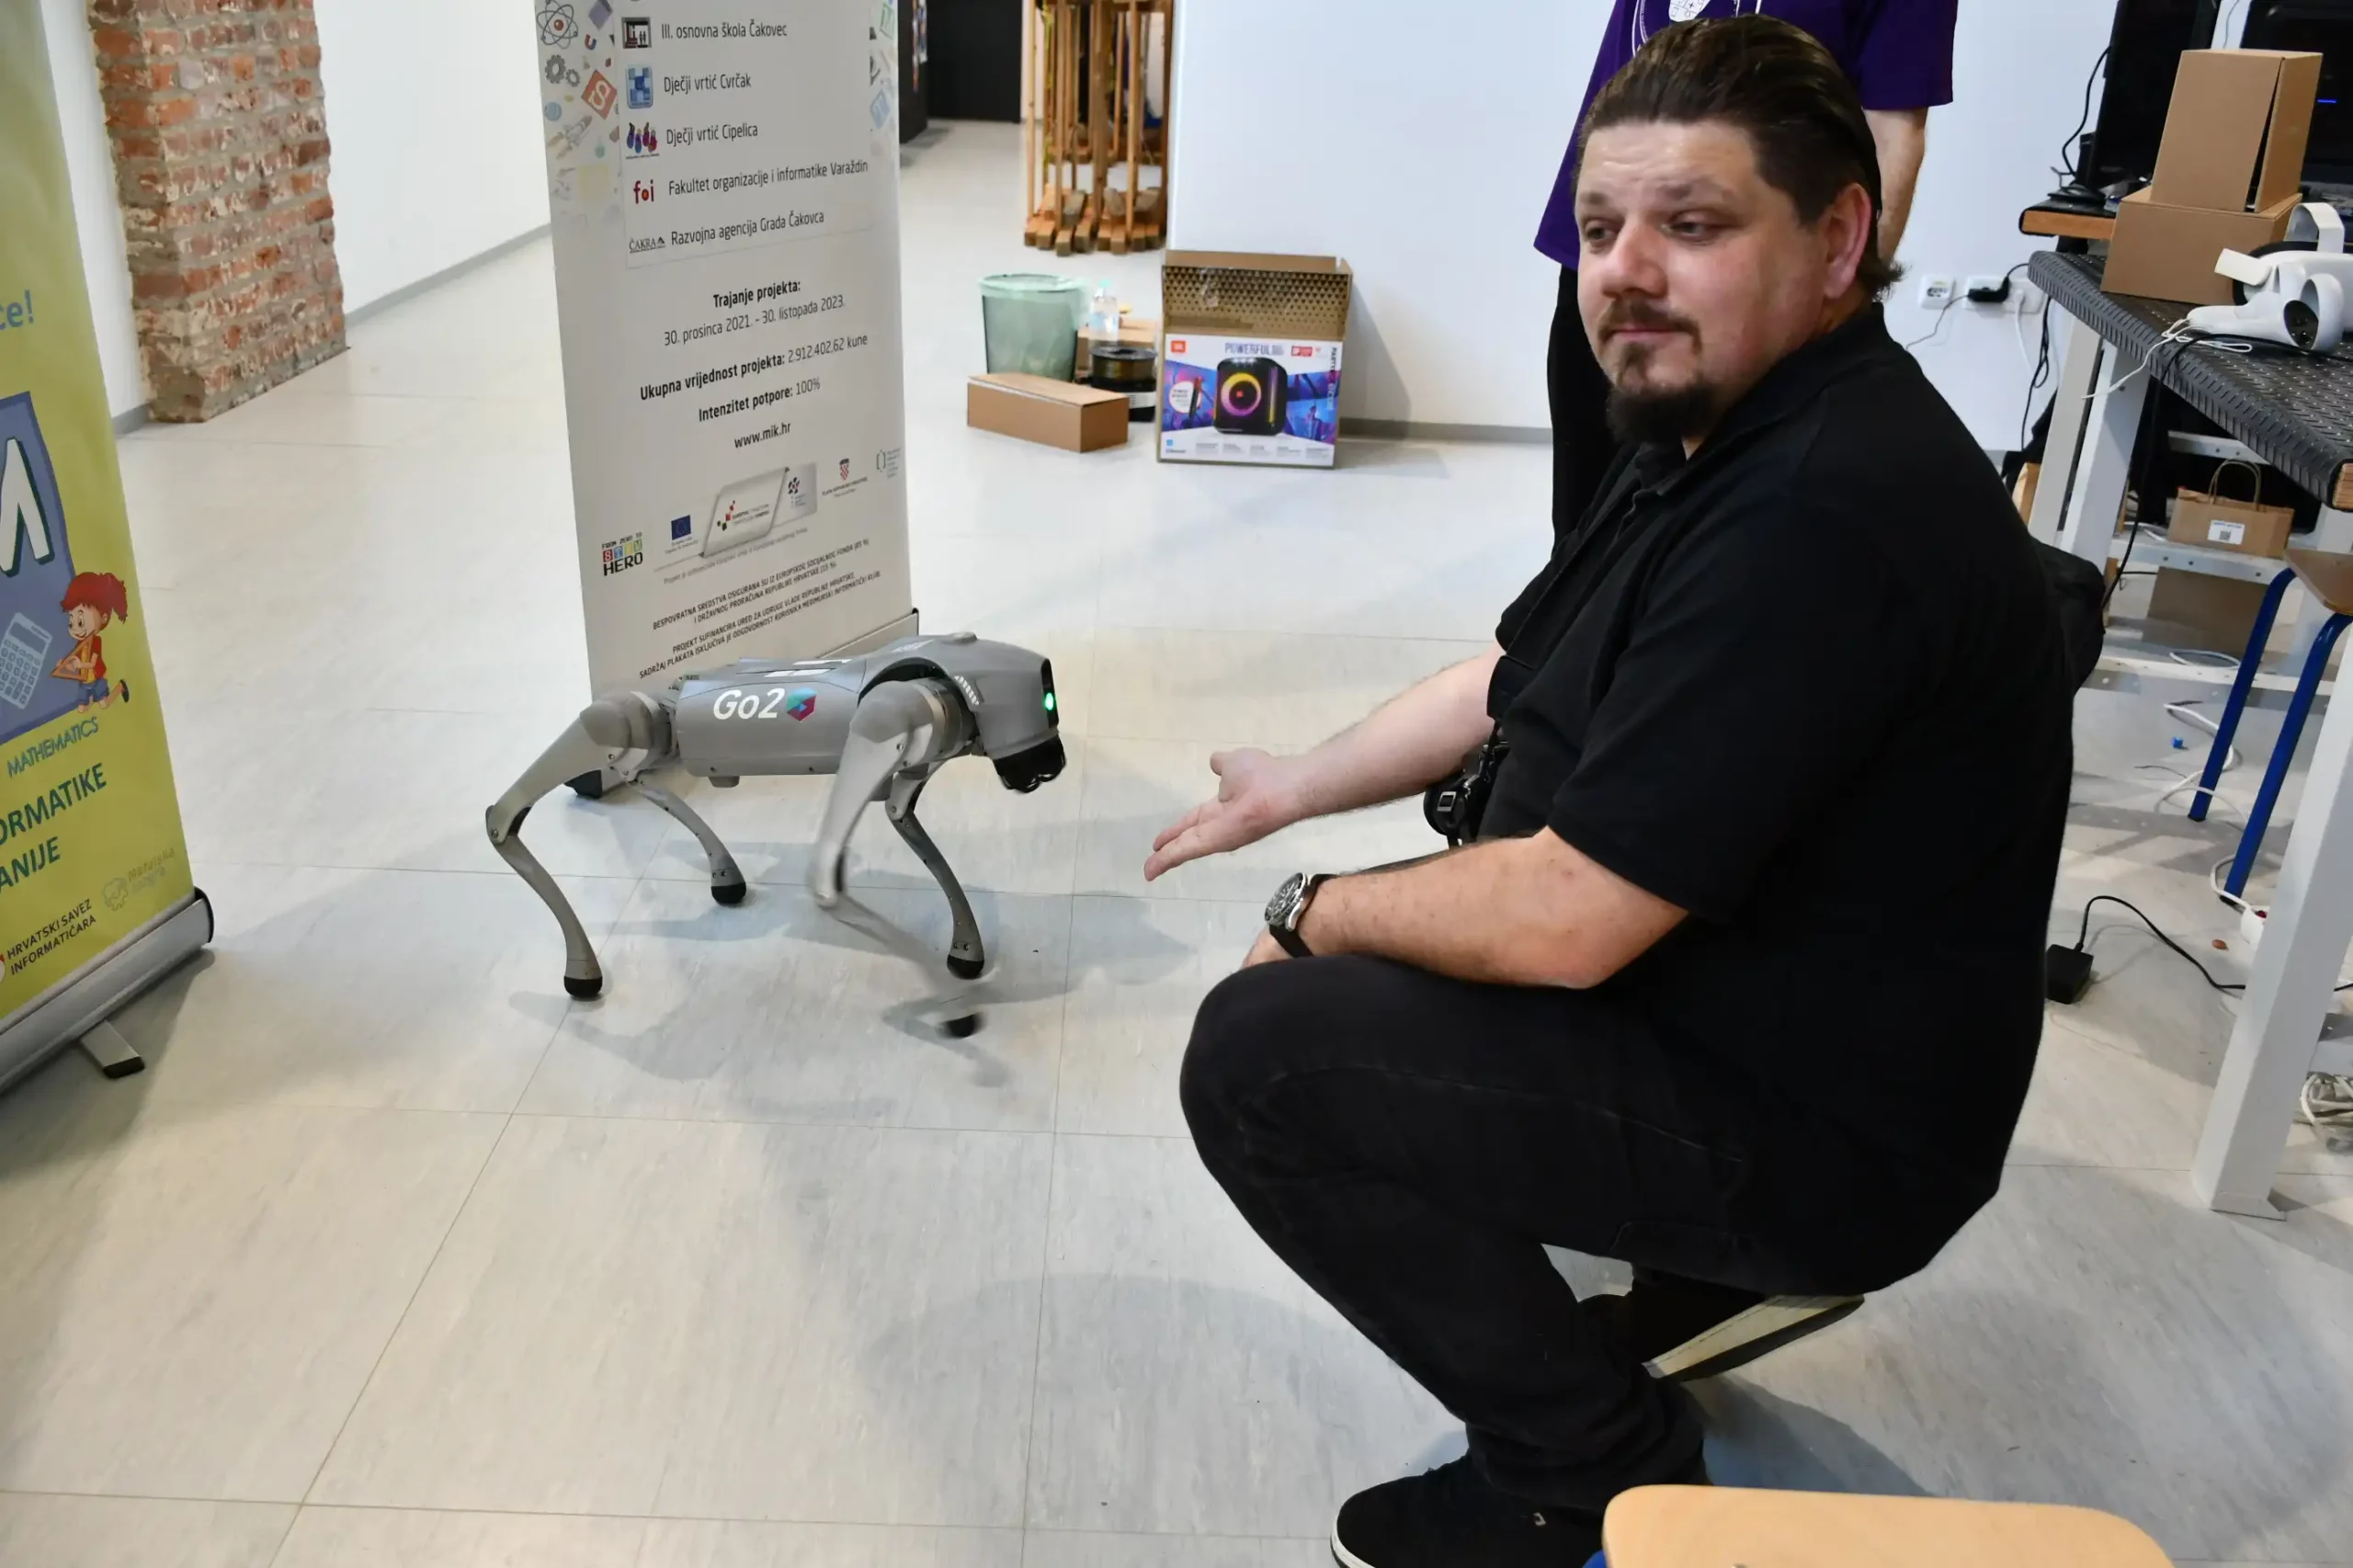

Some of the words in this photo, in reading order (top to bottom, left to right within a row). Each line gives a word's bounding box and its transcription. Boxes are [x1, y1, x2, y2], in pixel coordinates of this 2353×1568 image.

[662, 24, 675, 40] III.
[676, 25, 718, 39] osnovna
[722, 20, 746, 38] škola
[749, 18, 788, 37] Čakovec
[664, 74, 691, 94] Dječji
[695, 74, 717, 90] vrtić
[721, 73, 752, 90] Cvrčak
[666, 126, 694, 147] Dječji
[697, 124, 720, 142] vrtić
[722, 122, 758, 142] Cipelica
[633, 179, 654, 204] foi
[669, 176, 710, 197] Fakultet
[712, 171, 769, 195] organizacije
[771, 168, 775, 184] i
[777, 162, 827, 184] informatike
[830, 159, 869, 176] Varaždin
[629, 237, 656, 251] ČAKRA
[671, 226, 716, 246] Razvojna
[719, 221, 757, 242] agencija
[760, 213, 786, 232] Grada
[789, 209, 824, 228] Čakovca
[713, 286, 754, 309] Trajanje
[756, 279, 801, 302] projekta:
[665, 330, 680, 347] 30.
[683, 319, 723, 345] prosinca
[726, 314, 753, 333] 2021.
[763, 309, 776, 325] 30.
[779, 301, 818, 322] listopada
[641, 379, 682, 401] Ukupna
[685, 364, 738, 390] vrijednost
[741, 354, 785, 379] projekta:
[847, 333, 868, 349] kune
[699, 397, 750, 422] Intenzitet
[753, 385, 793, 409] potpore:
[796, 377, 821, 396] 100%
[734, 421, 791, 449] www.mik.hr
[603, 551, 643, 576] HERO
[653, 606, 697, 631] BESPOVRATNA
[698, 593, 727, 613] SREDSTVA
[727, 581, 760, 600] OSIGURANA
[761, 577, 769, 587] SU
[698, 604, 730, 623] DRŽAVNOG
[730, 590, 765, 609] PRORAČUNA
[673, 637, 699, 654] PROJEKT
[699, 621, 737, 643] SUFINANCIRA
[737, 614, 753, 627] URED
[754, 611, 762, 621] ZA
[762, 601, 784, 617] UDRUGE
[639, 662, 666, 679] SADRŽAJ
[667, 649, 695, 666] PLAKATA
[695, 635, 726, 655] ISKLJUČIVA
[726, 632, 733, 644] JE
[733, 617, 774, 639] ODGOVORNOST
[713, 688, 785, 719] Go2
[6, 716, 99, 778] MATHEMATICS
[7, 920, 61, 960] HRVATSKI
[62, 898, 93, 926] SAVEZ
[10, 915, 97, 976] INFORMATIČARA
